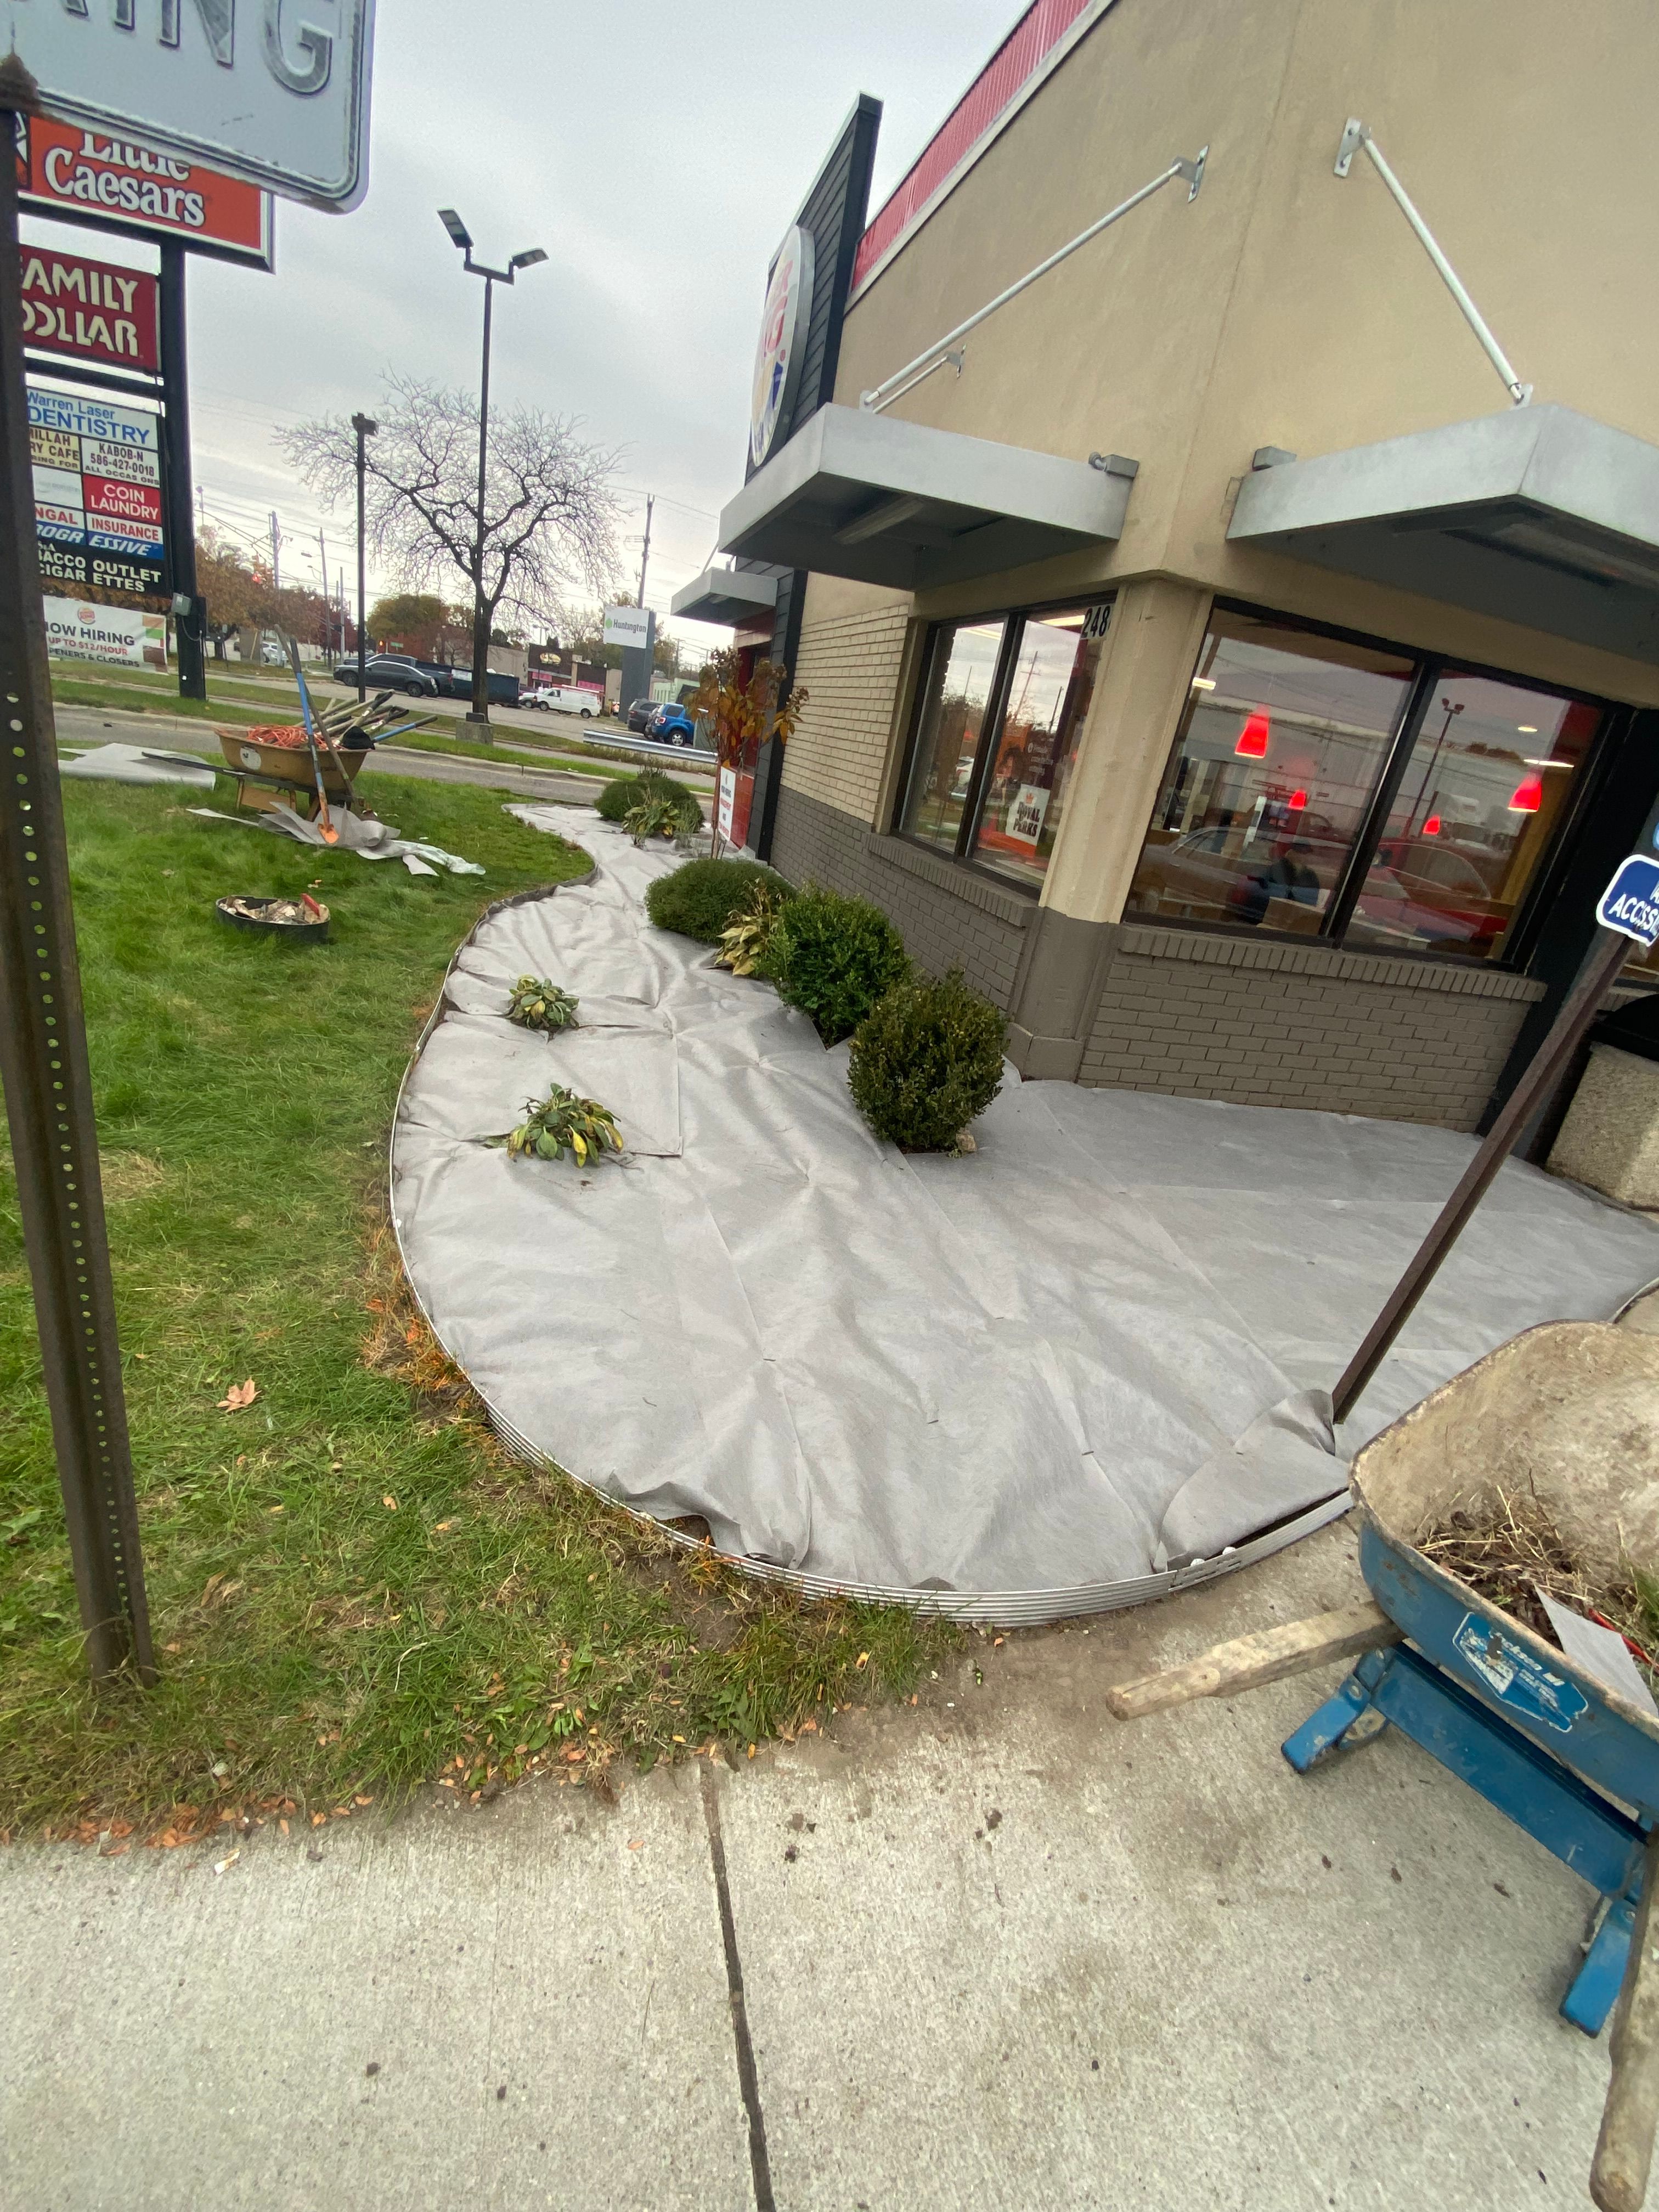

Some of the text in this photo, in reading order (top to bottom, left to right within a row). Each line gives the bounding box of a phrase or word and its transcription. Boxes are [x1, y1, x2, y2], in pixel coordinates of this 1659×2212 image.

[45, 147, 205, 227] Caesars
[20, 255, 139, 313] AMILY
[28, 391, 115, 420] Warren Laser
[28, 405, 150, 444] DENTISTRY
[49, 445, 80, 461] CAFE
[59, 460, 78, 469] FOR
[91, 453, 154, 476] 586-427-0018
[104, 484, 145, 503] COIN
[91, 495, 159, 520] LAUNDRY
[92, 518, 159, 541] INSURANCE
[89, 535, 151, 556] ESSIVE
[93, 560, 161, 583] OUTLET
[93, 574, 145, 592] ETTES
[613, 619, 646, 633] Huntington
[49, 636, 61, 645] UP
[63, 639, 76, 647] TO
[81, 628, 134, 646] HIRING
[97, 656, 140, 668] CLOSERS
